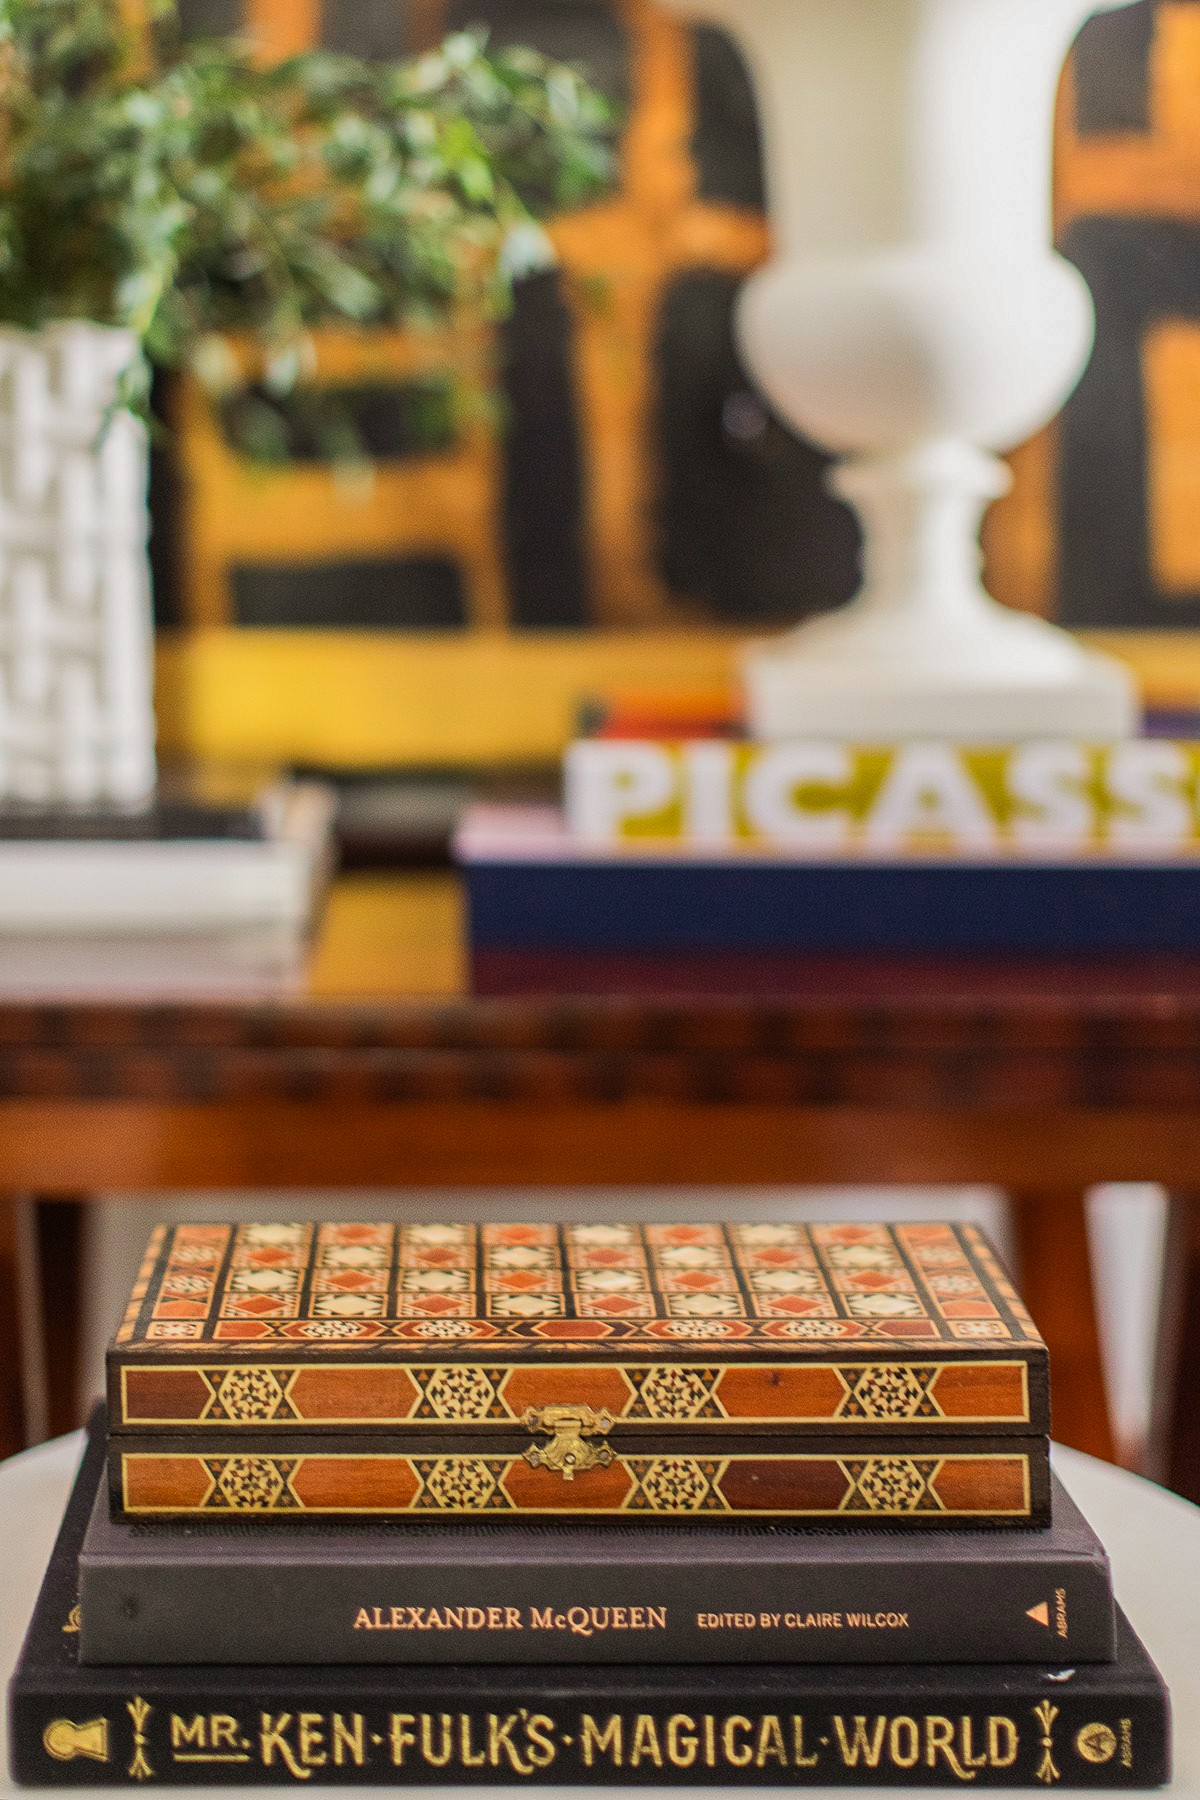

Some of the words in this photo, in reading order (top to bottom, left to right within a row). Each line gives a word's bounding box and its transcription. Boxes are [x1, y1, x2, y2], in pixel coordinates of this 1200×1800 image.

[565, 738, 1200, 857] PICASS
[352, 1607, 523, 1630] ALEXANDER
[530, 1606, 667, 1637] McQUEEN
[697, 1613, 757, 1629] EDITED
[760, 1613, 782, 1629] BY
[784, 1612, 843, 1628] CLAIRE
[846, 1612, 910, 1628] WILCOX
[1055, 1587, 1069, 1639] ABRAMS
[170, 1713, 251, 1749] MR.
[259, 1711, 365, 1779] KEN
[578, 1713, 819, 1768] MAGICAL
[832, 1714, 1020, 1780] WORLD
